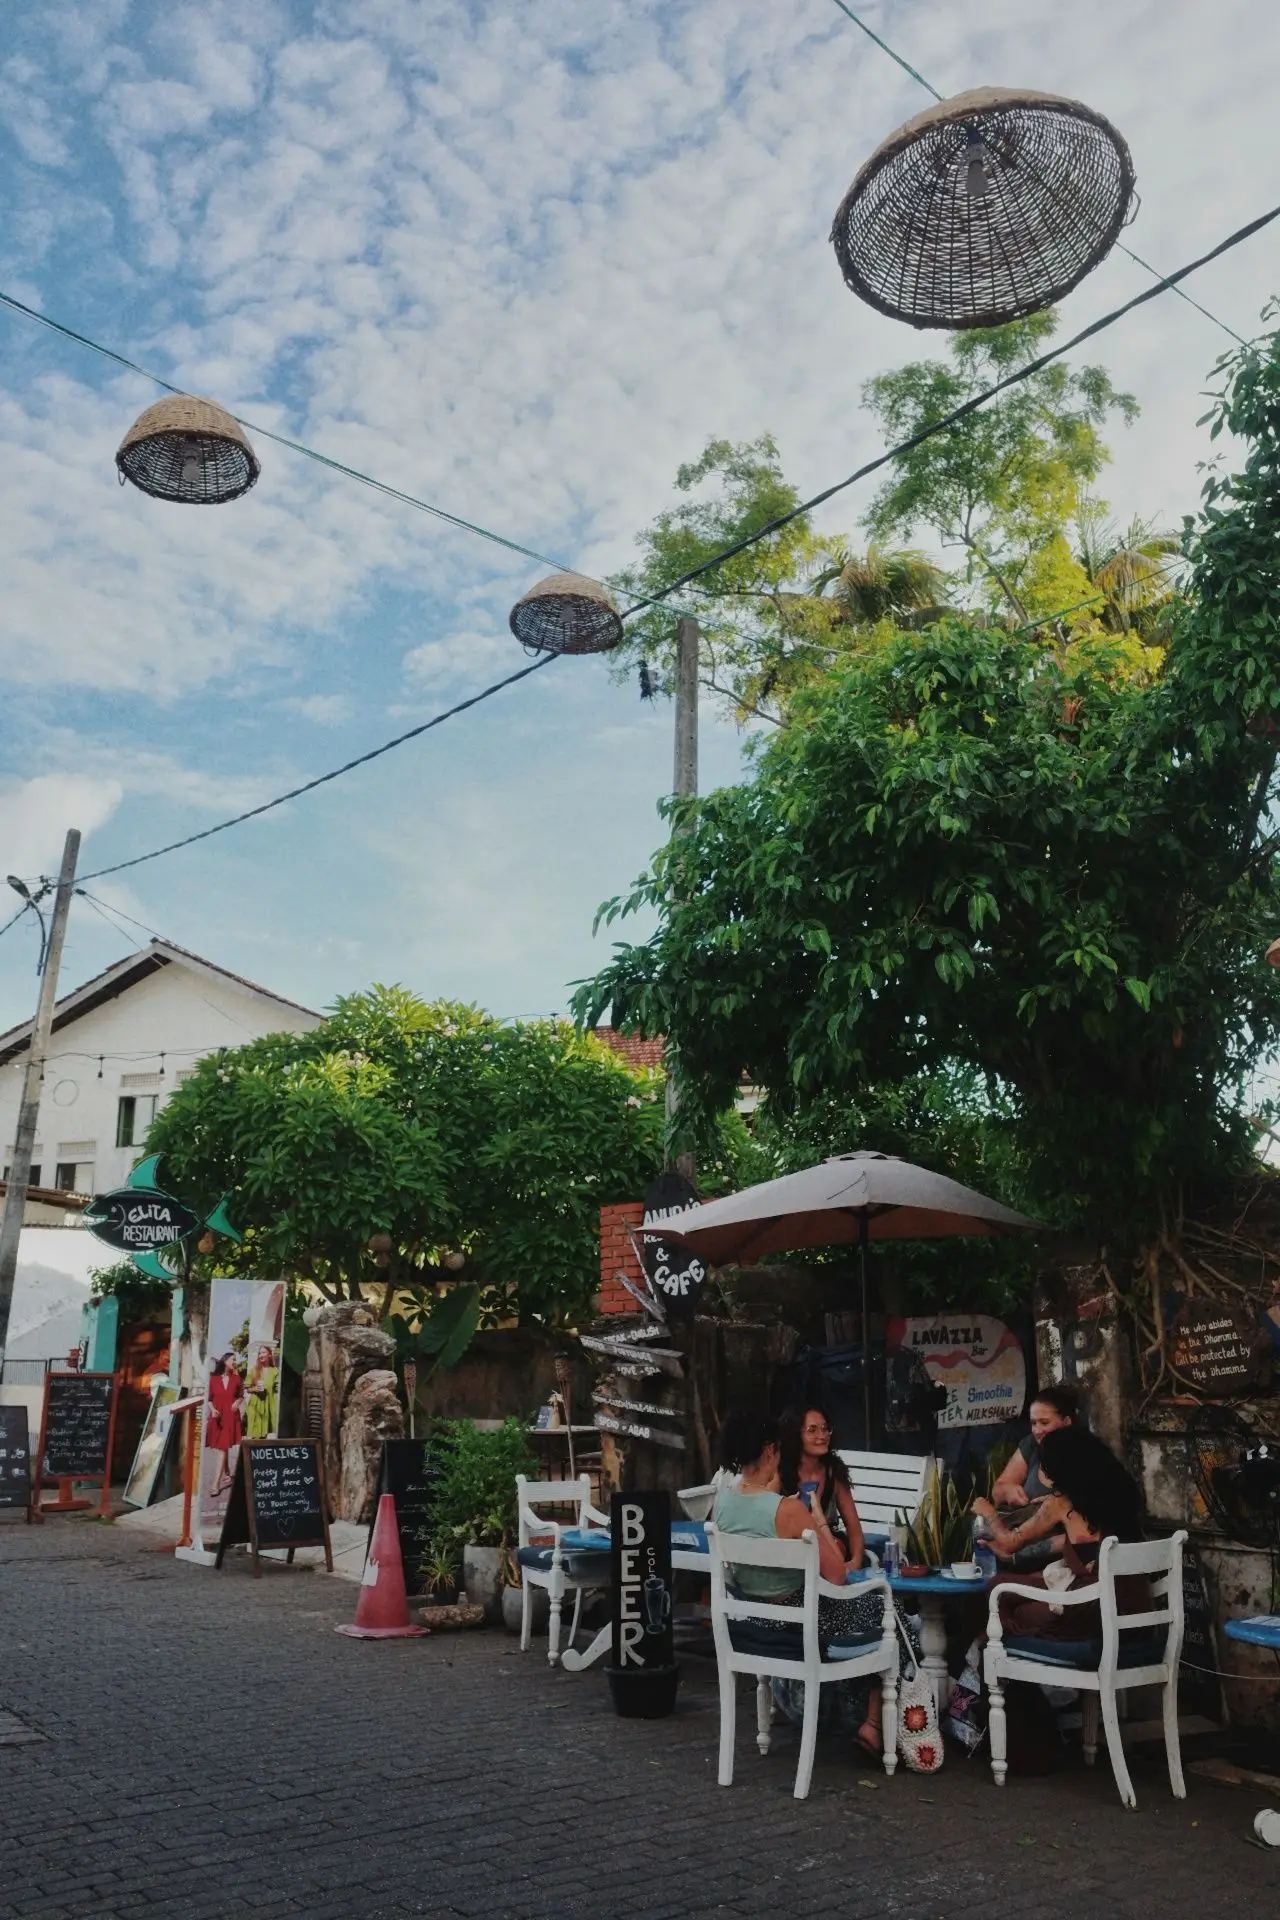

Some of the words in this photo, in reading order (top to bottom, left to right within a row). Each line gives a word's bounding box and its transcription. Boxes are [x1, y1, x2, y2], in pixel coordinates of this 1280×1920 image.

[123, 1226, 181, 1241] RESTAURANT
[656, 1248, 669, 1261] &
[654, 1259, 705, 1296] CAFE
[1193, 1322, 1207, 1333] who
[1208, 1318, 1233, 1331] abides
[912, 1326, 982, 1345] LAVAZZA
[1188, 1337, 1201, 1348] the
[972, 1346, 988, 1357] Bar
[1189, 1353, 1199, 1364] be
[1200, 1345, 1237, 1362] protected
[1240, 1343, 1251, 1359] by
[1192, 1368, 1207, 1381] the
[967, 1385, 1012, 1404] Smoothie
[940, 1404, 963, 1423] TEA
[966, 1405, 1017, 1421] MILKSHAKE
[251, 1446, 309, 1460] NOELINE'S
[253, 1467, 278, 1480] Pretty
[620, 1503, 646, 1667] BEER
